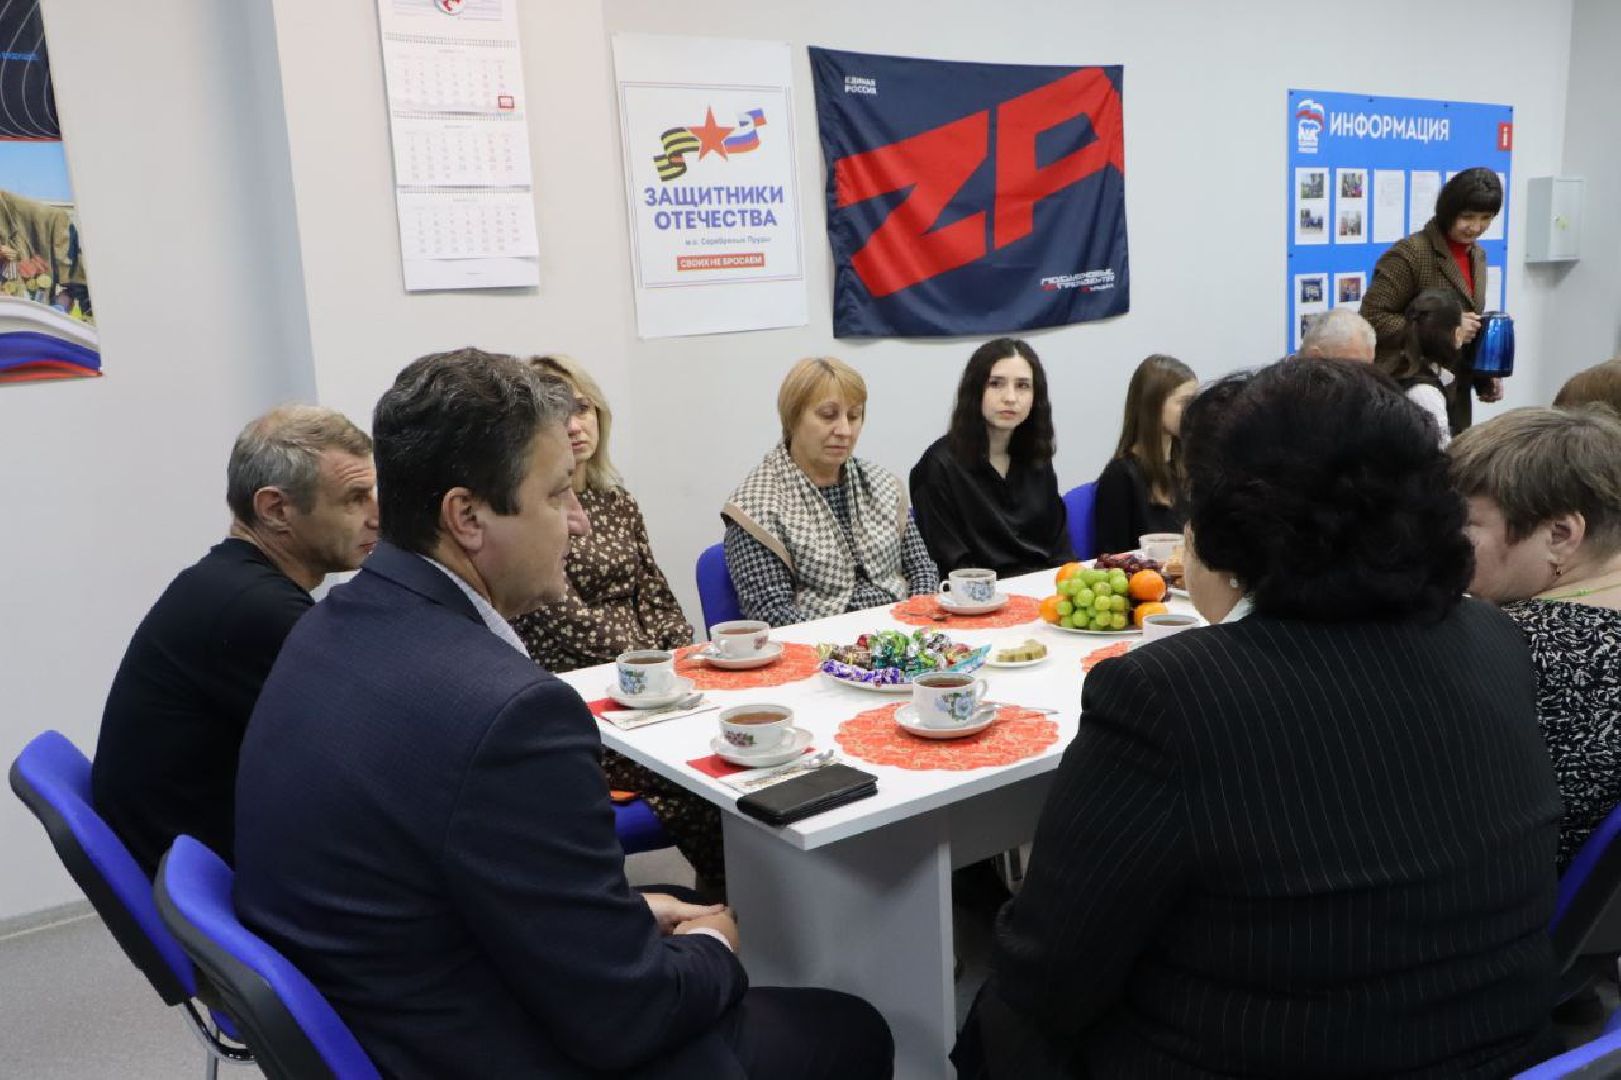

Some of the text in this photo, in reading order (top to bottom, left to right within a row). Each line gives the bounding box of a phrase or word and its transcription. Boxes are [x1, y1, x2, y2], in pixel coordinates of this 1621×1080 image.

[844, 85, 877, 94] РОССИЯ
[1329, 111, 1449, 144] ИНФОРМАЦИЯ
[644, 186, 784, 207] ЗАЩИТНИКИ
[655, 210, 777, 230] ОТЕЧЕСТВА
[680, 256, 762, 268] СВОИХ НЕ БРОСАЕМ
